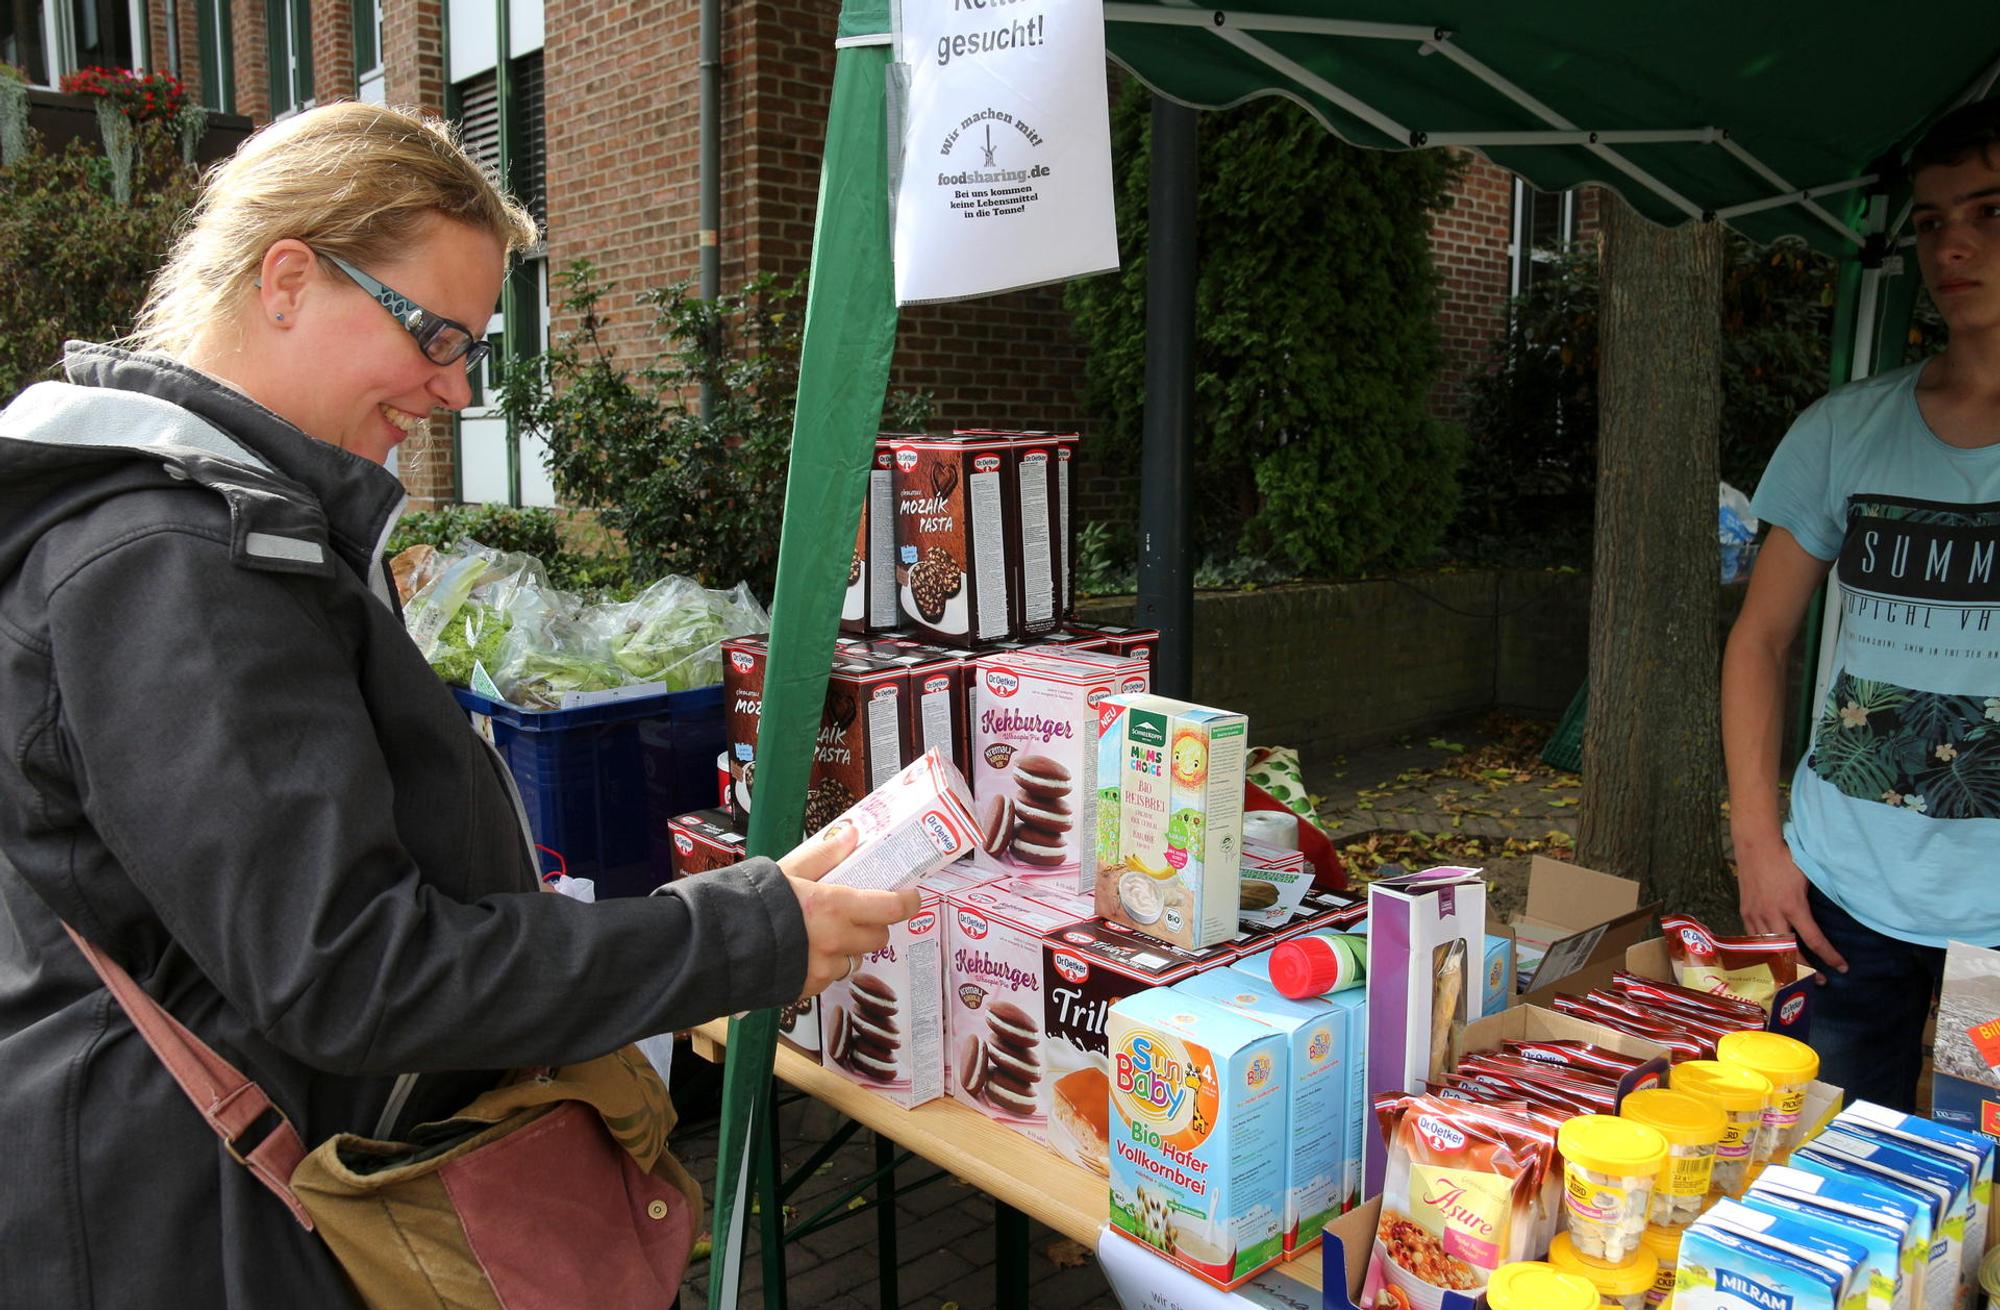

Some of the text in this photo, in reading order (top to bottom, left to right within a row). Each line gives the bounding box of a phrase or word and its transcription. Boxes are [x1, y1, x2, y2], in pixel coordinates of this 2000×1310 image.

[937, 15, 1043, 66] gesucht!
[941, 108, 1043, 156] Wir machen mit!
[938, 164, 1050, 186] foodsharing.de
[950, 193, 1038, 209] keine Lebensmittel
[954, 186, 1032, 199] Bei uns kommen
[964, 205, 1025, 218] in die Tonne!
[920, 516, 953, 533] PASTA
[1100, 706, 1117, 729] NEU
[1130, 760, 1162, 777] CHOICE
[1131, 746, 1162, 763] MUMS
[1052, 988, 1109, 1037] Tril
[1131, 1037, 1183, 1083] Sun
[1115, 1052, 1185, 1119] Baby
[1132, 1120, 1209, 1174] Bio Hafer
[1117, 1139, 1207, 1196] Vollkornbrei
[1722, 1274, 1787, 1310] MILRAM
